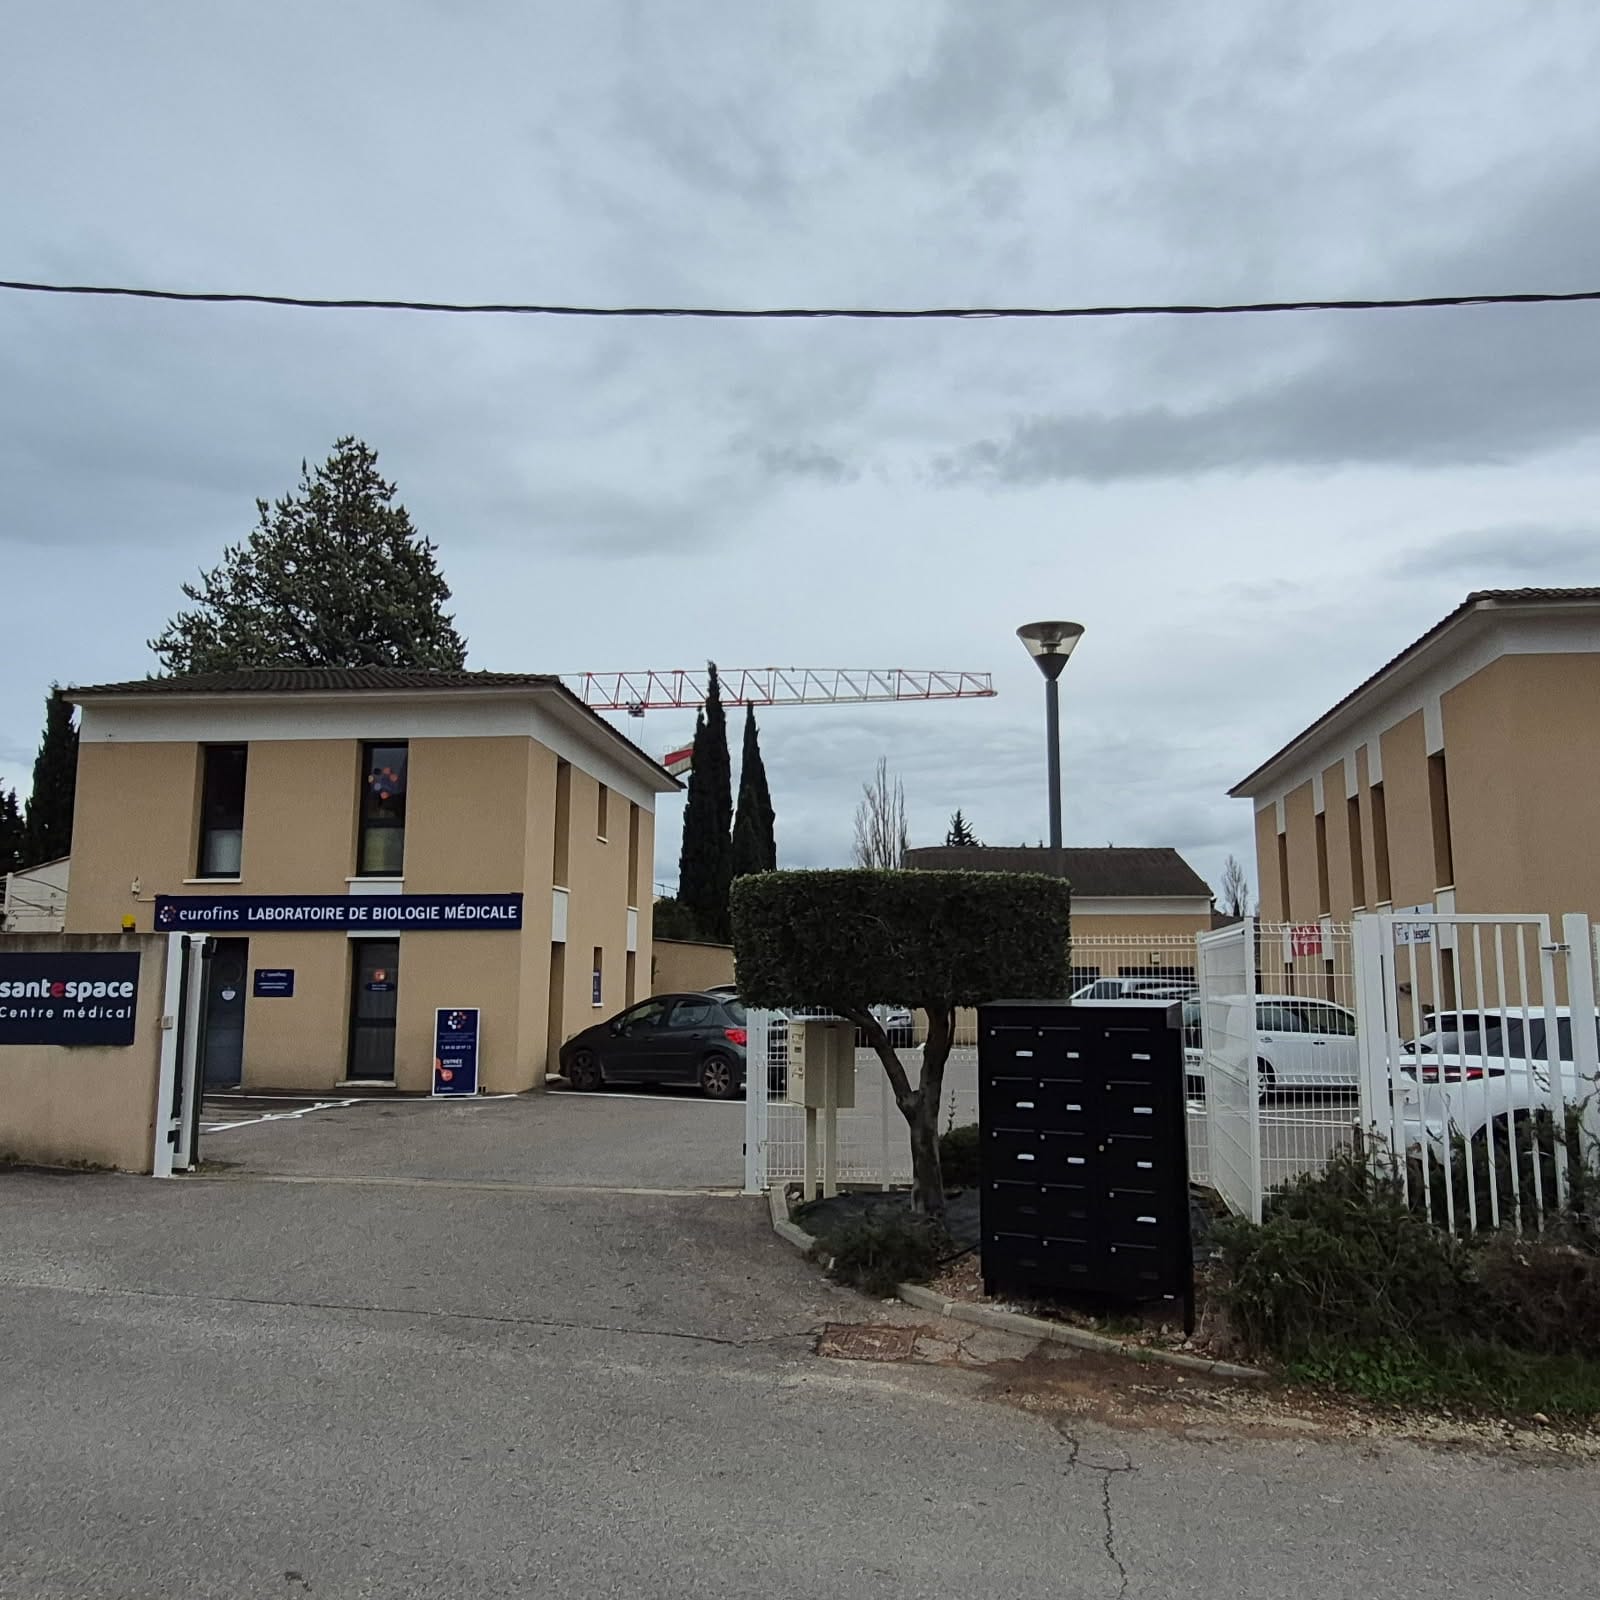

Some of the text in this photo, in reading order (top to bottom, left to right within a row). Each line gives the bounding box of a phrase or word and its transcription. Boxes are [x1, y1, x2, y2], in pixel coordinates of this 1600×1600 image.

[179, 904, 518, 921] eurofins LABORATOIRE DE BIOLOGIE MÉDICALE
[0, 978, 134, 1003] santespace
[0, 1006, 131, 1019] Centre médical
